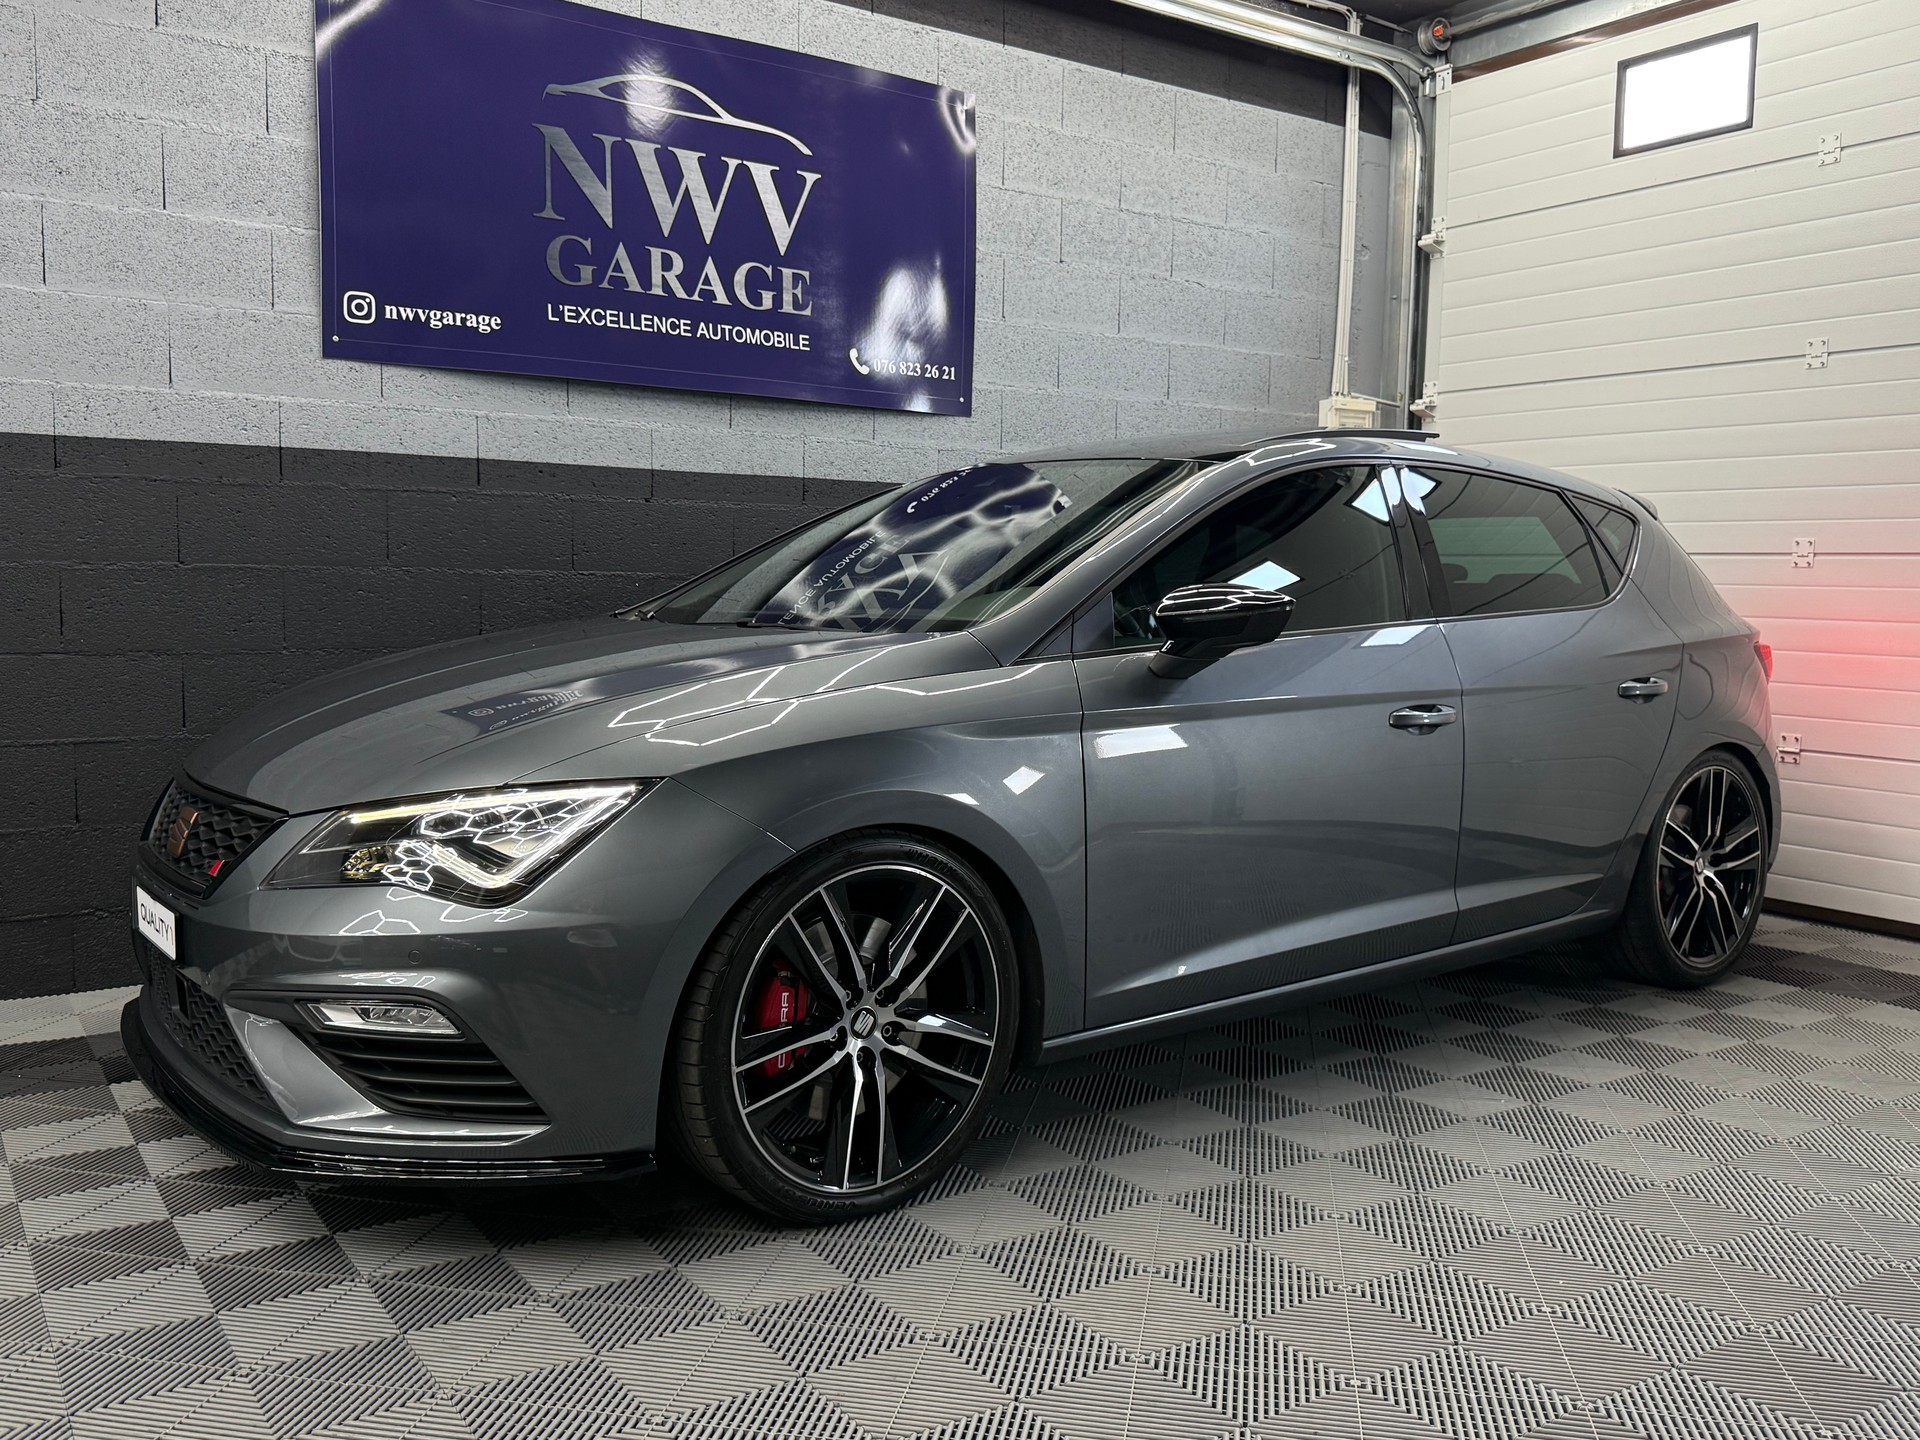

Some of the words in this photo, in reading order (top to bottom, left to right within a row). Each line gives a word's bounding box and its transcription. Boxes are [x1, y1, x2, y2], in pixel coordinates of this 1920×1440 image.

[532, 123, 821, 256] NWV
[546, 234, 813, 316] GARAGE
[384, 303, 502, 333] nwvgarage
[547, 303, 692, 337] L'EXCELLENCE
[696, 321, 811, 351] AUTOMOBILE
[873, 359, 897, 374] 076
[899, 360, 921, 377] 823
[924, 363, 939, 379] 26
[941, 365, 956, 380] 21
